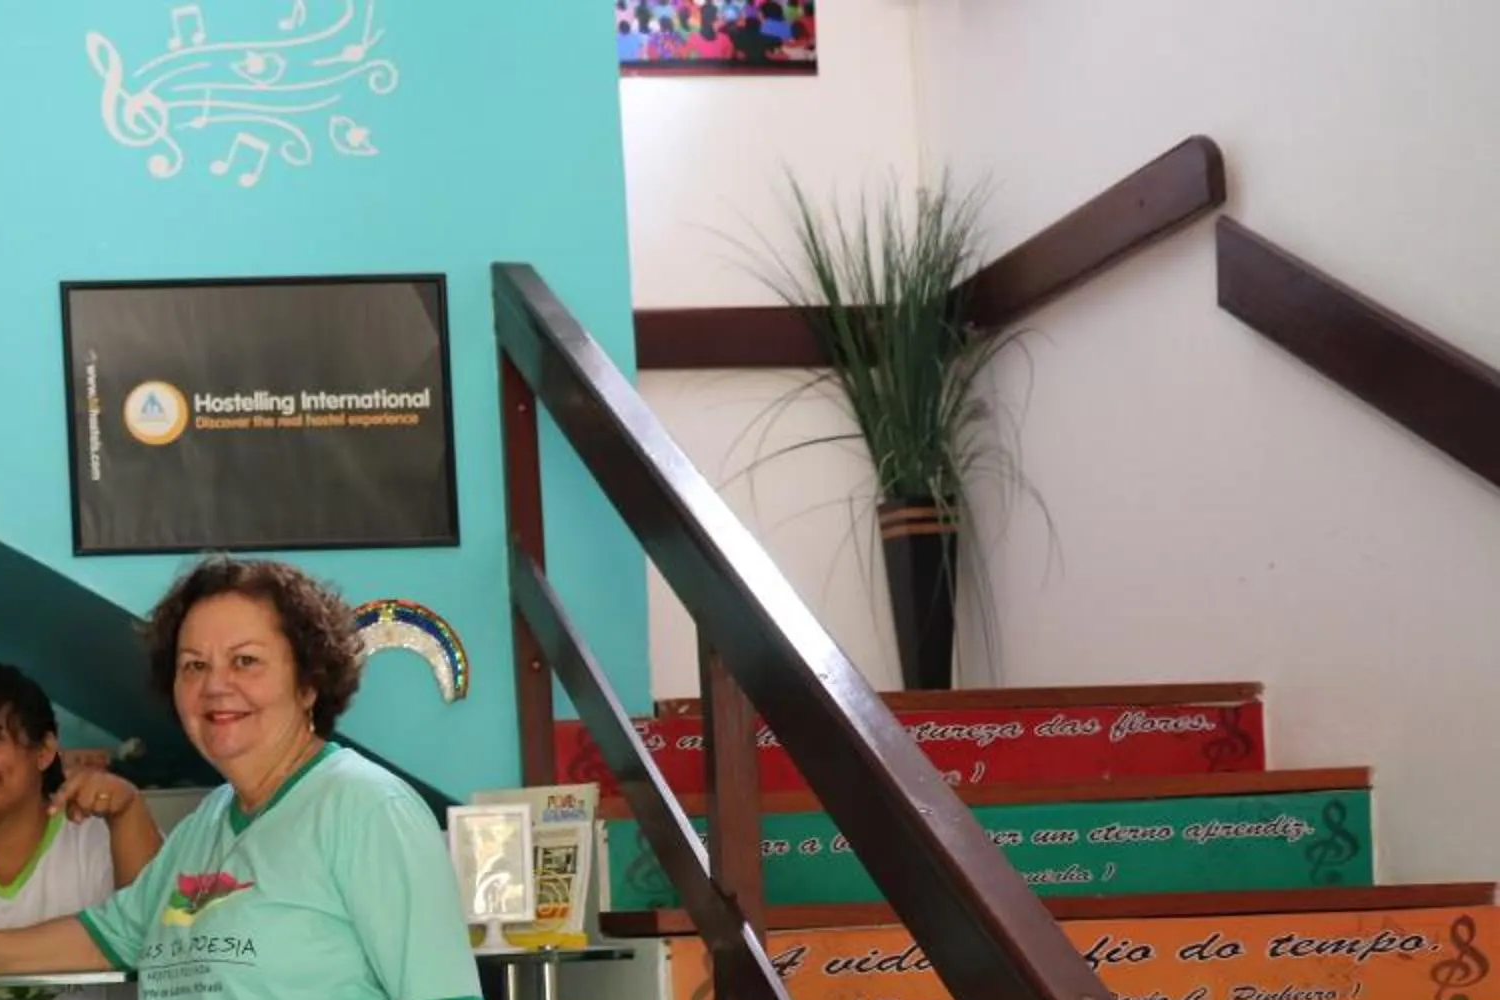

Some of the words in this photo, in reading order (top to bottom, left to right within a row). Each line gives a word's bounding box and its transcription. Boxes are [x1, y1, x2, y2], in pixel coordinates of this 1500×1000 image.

[194, 391, 295, 415] Hostelling
[301, 388, 431, 410] International
[1035, 714, 1101, 738] das
[1109, 710, 1217, 742] flores.
[1031, 828, 1079, 845] um
[1086, 821, 1175, 843] eterno
[1182, 815, 1315, 843] aprendiz.
[1177, 932, 1245, 965] do
[1267, 929, 1442, 963] tempo.
